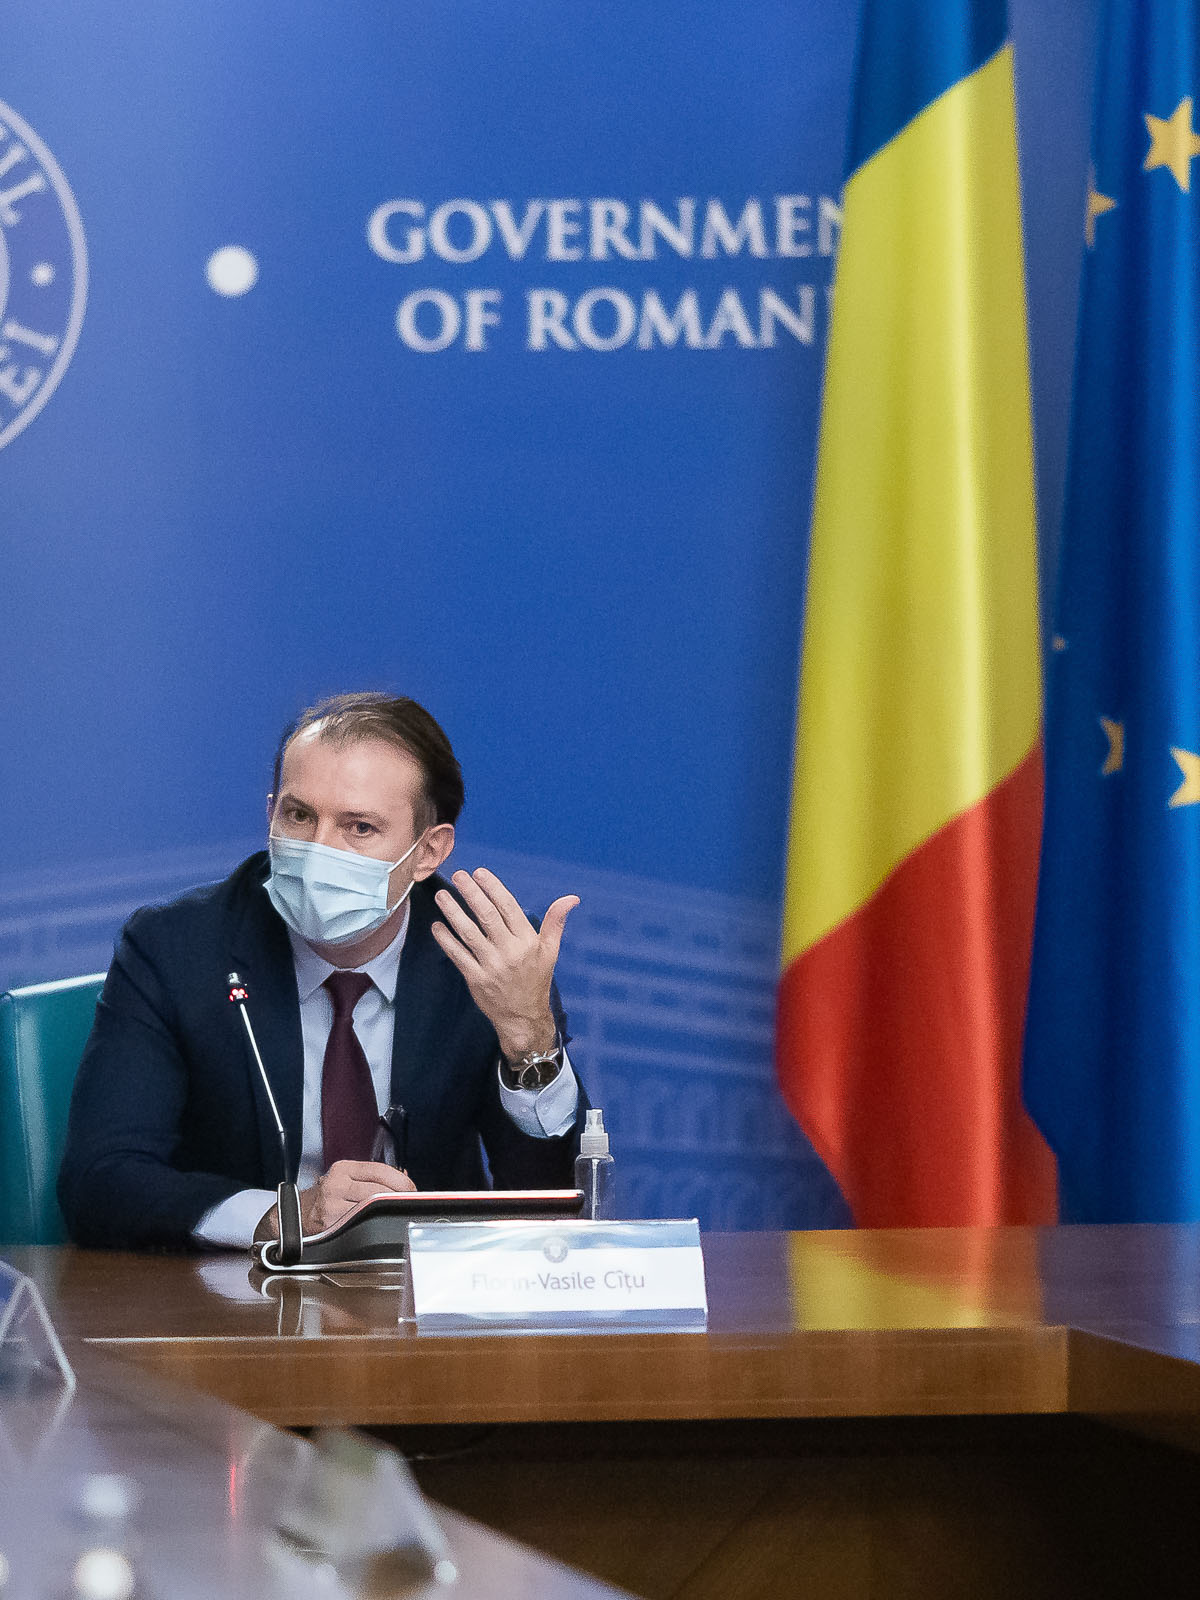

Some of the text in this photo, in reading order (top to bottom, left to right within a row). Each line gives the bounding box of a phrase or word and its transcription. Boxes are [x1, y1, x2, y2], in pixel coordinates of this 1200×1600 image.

[366, 194, 845, 263] GOVERNMEN
[396, 285, 836, 353] OF ROMAN
